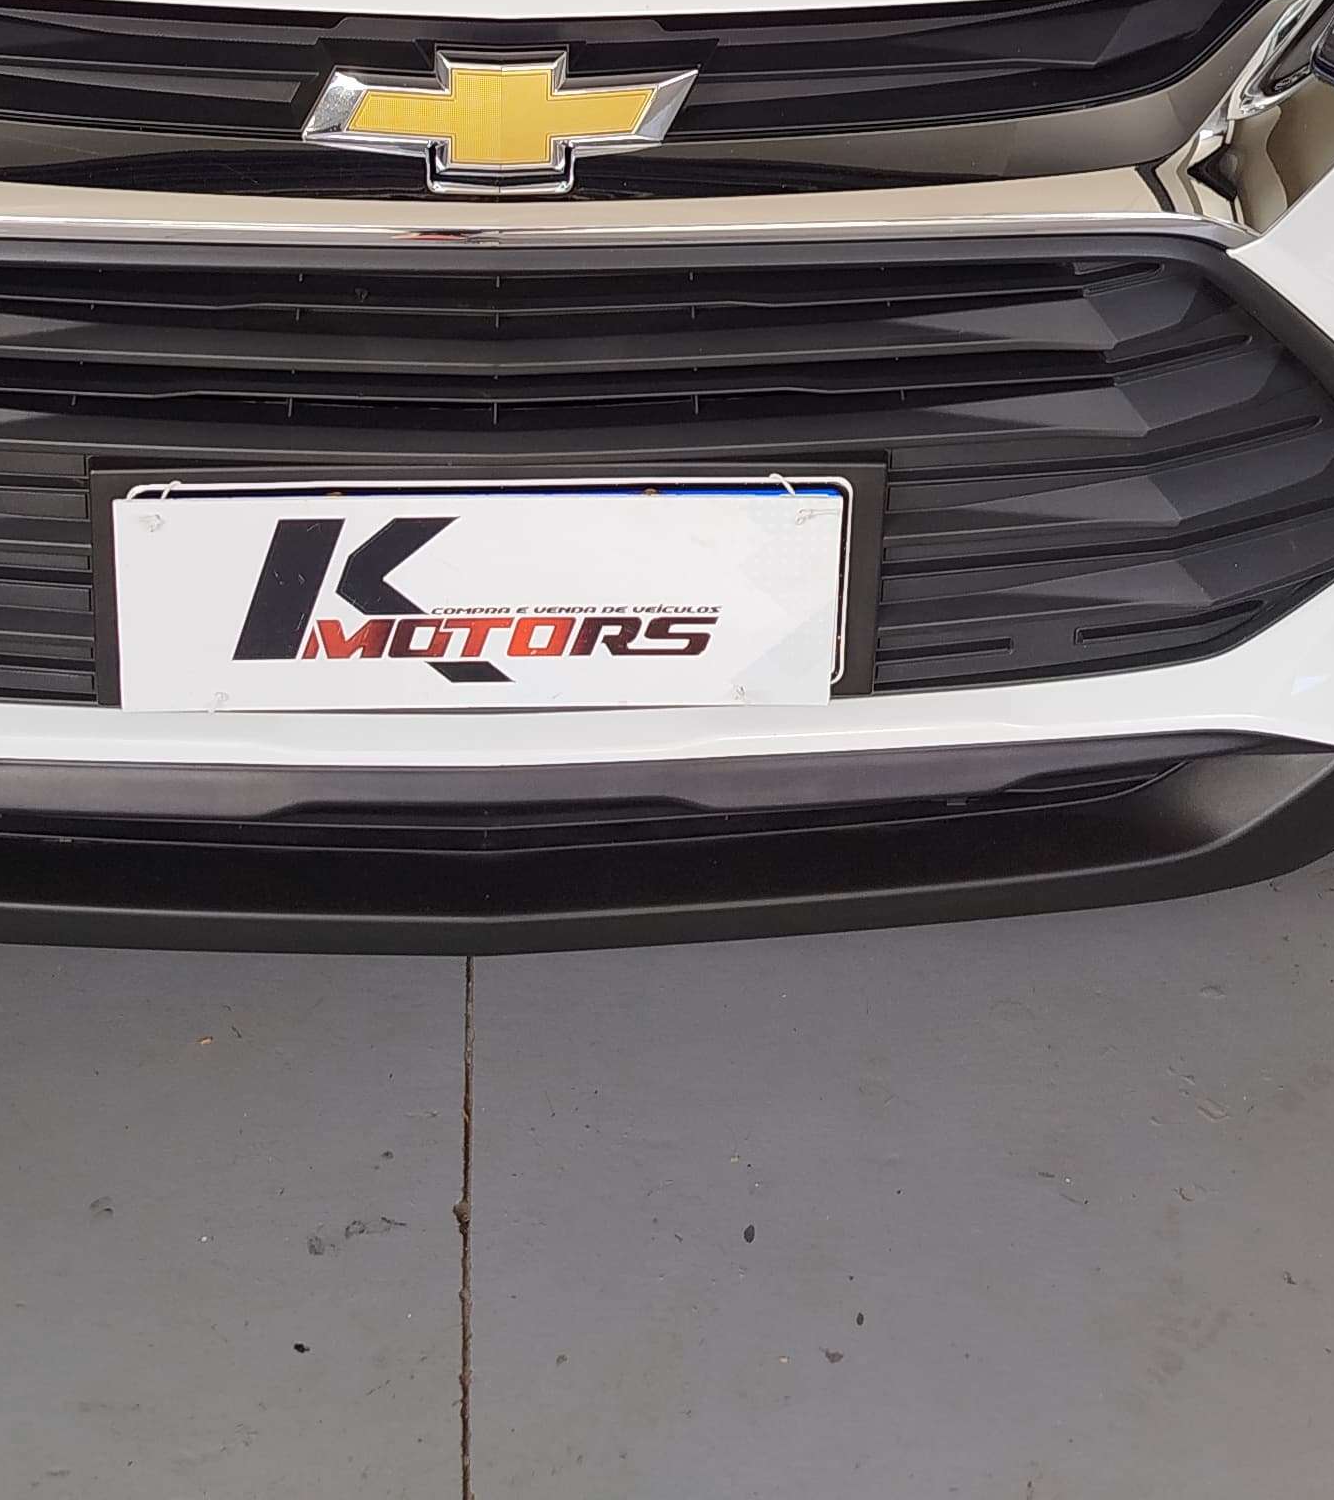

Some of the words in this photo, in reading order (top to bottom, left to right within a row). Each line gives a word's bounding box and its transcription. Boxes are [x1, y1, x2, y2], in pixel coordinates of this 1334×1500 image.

[232, 516, 515, 683] K
[431, 606, 511, 615] COMPRA
[516, 606, 527, 614] E
[534, 605, 596, 614] VENDA
[602, 605, 628, 614] DE
[632, 603, 723, 614] VEÍCULOS
[301, 615, 719, 660] MOTORS
